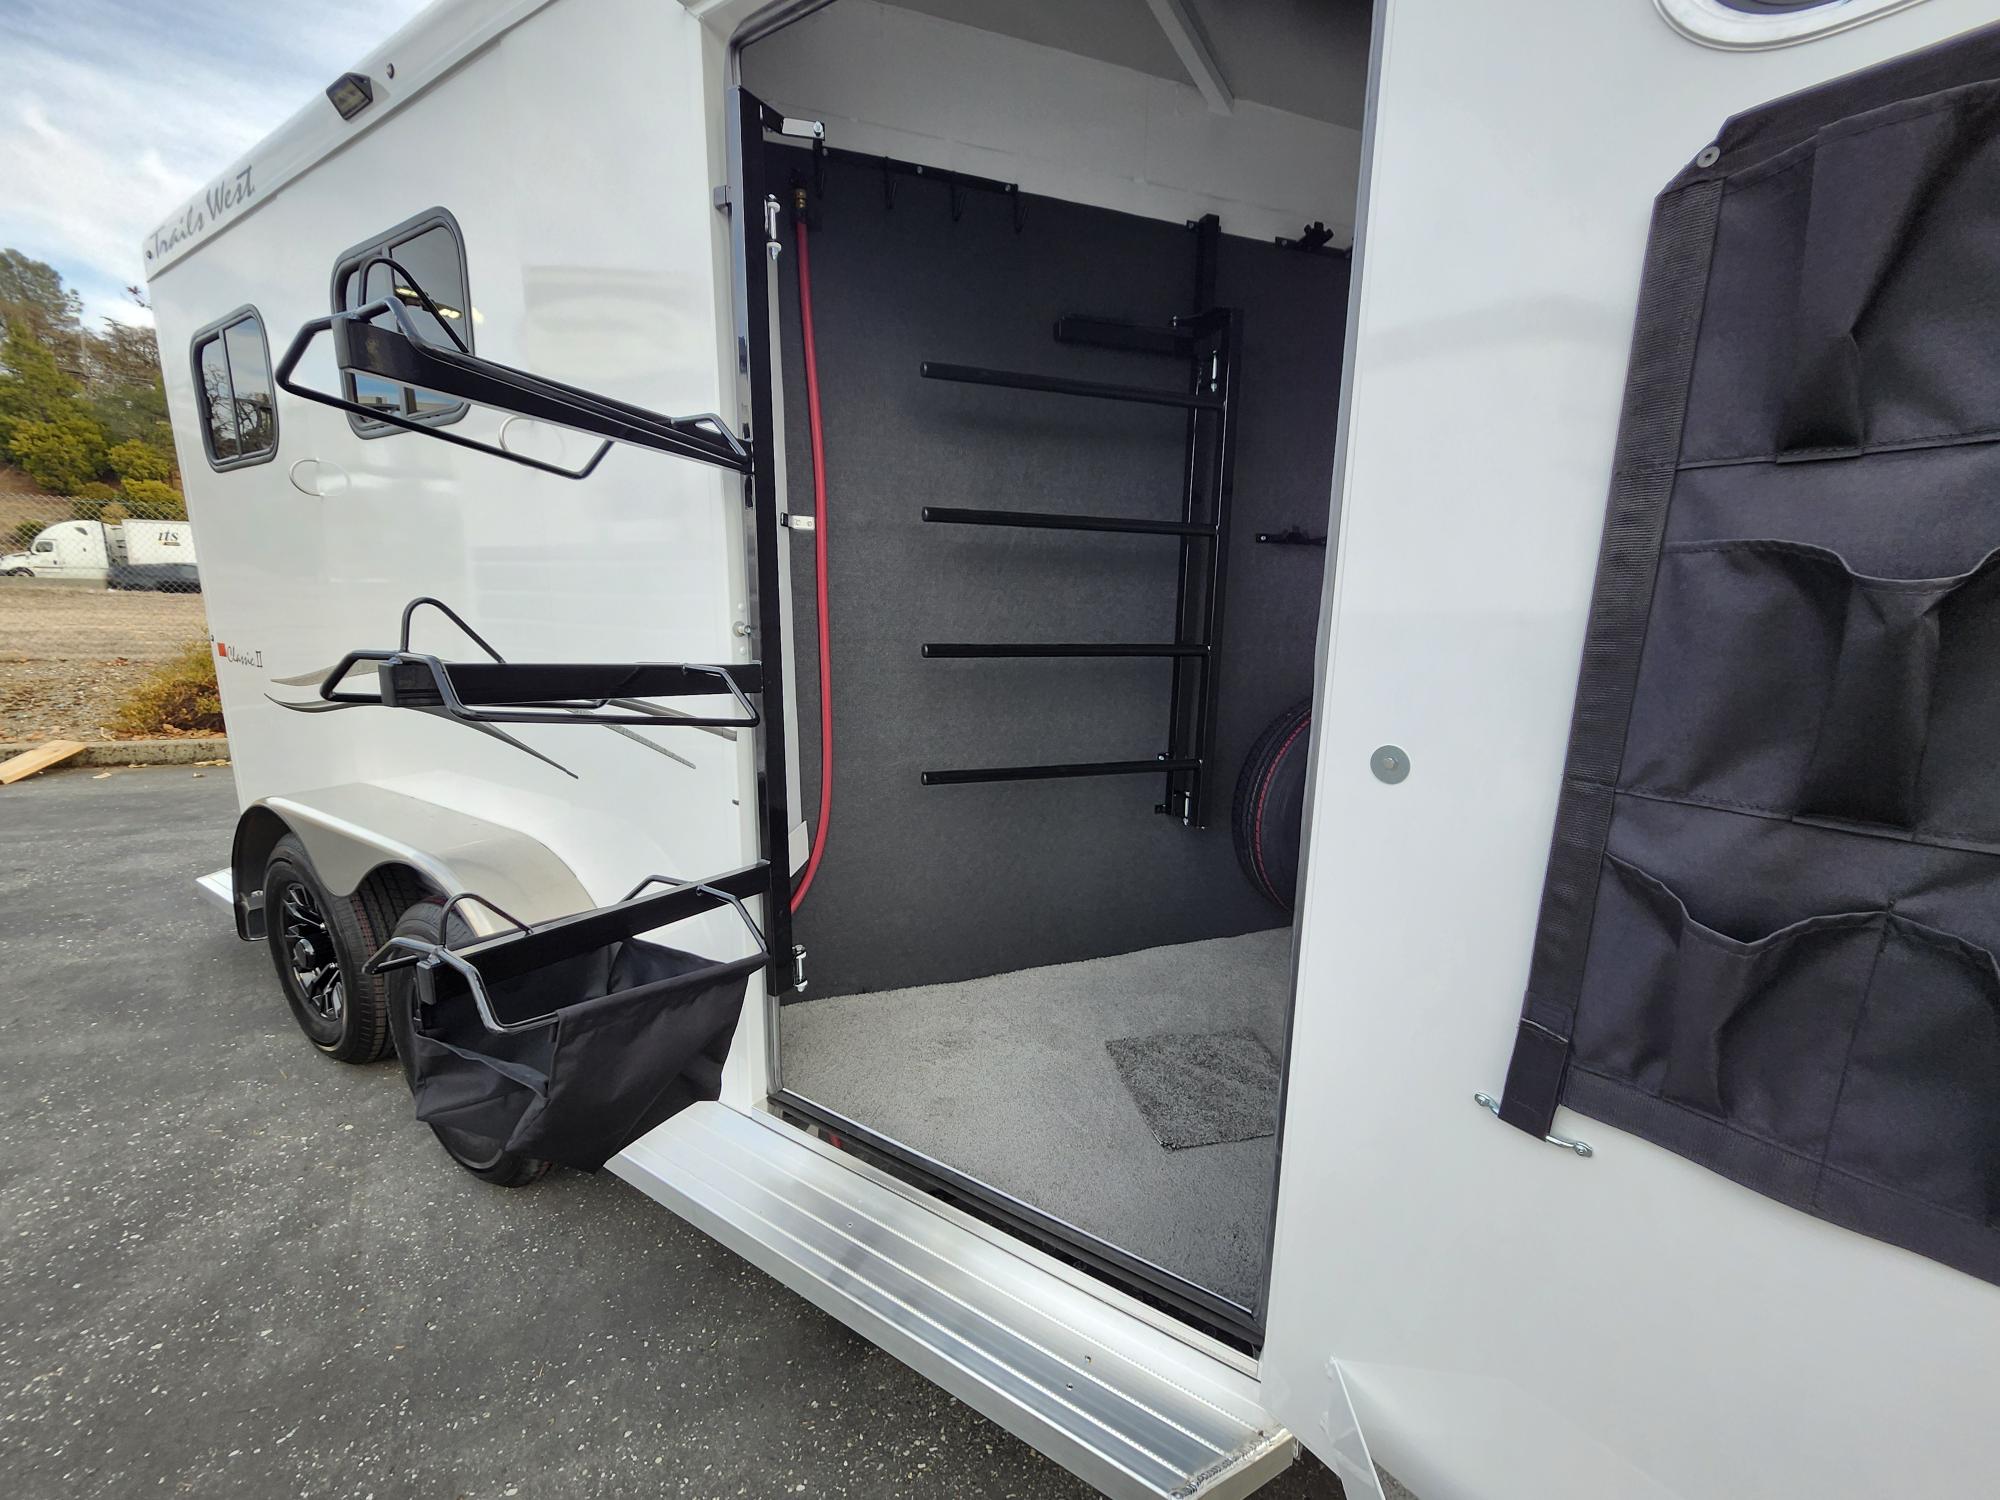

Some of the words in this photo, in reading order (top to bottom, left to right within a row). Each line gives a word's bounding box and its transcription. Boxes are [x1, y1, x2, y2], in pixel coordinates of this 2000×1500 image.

[150, 205, 204, 258] Trails
[206, 165, 255, 221] West
[227, 646, 255, 666] Classic
